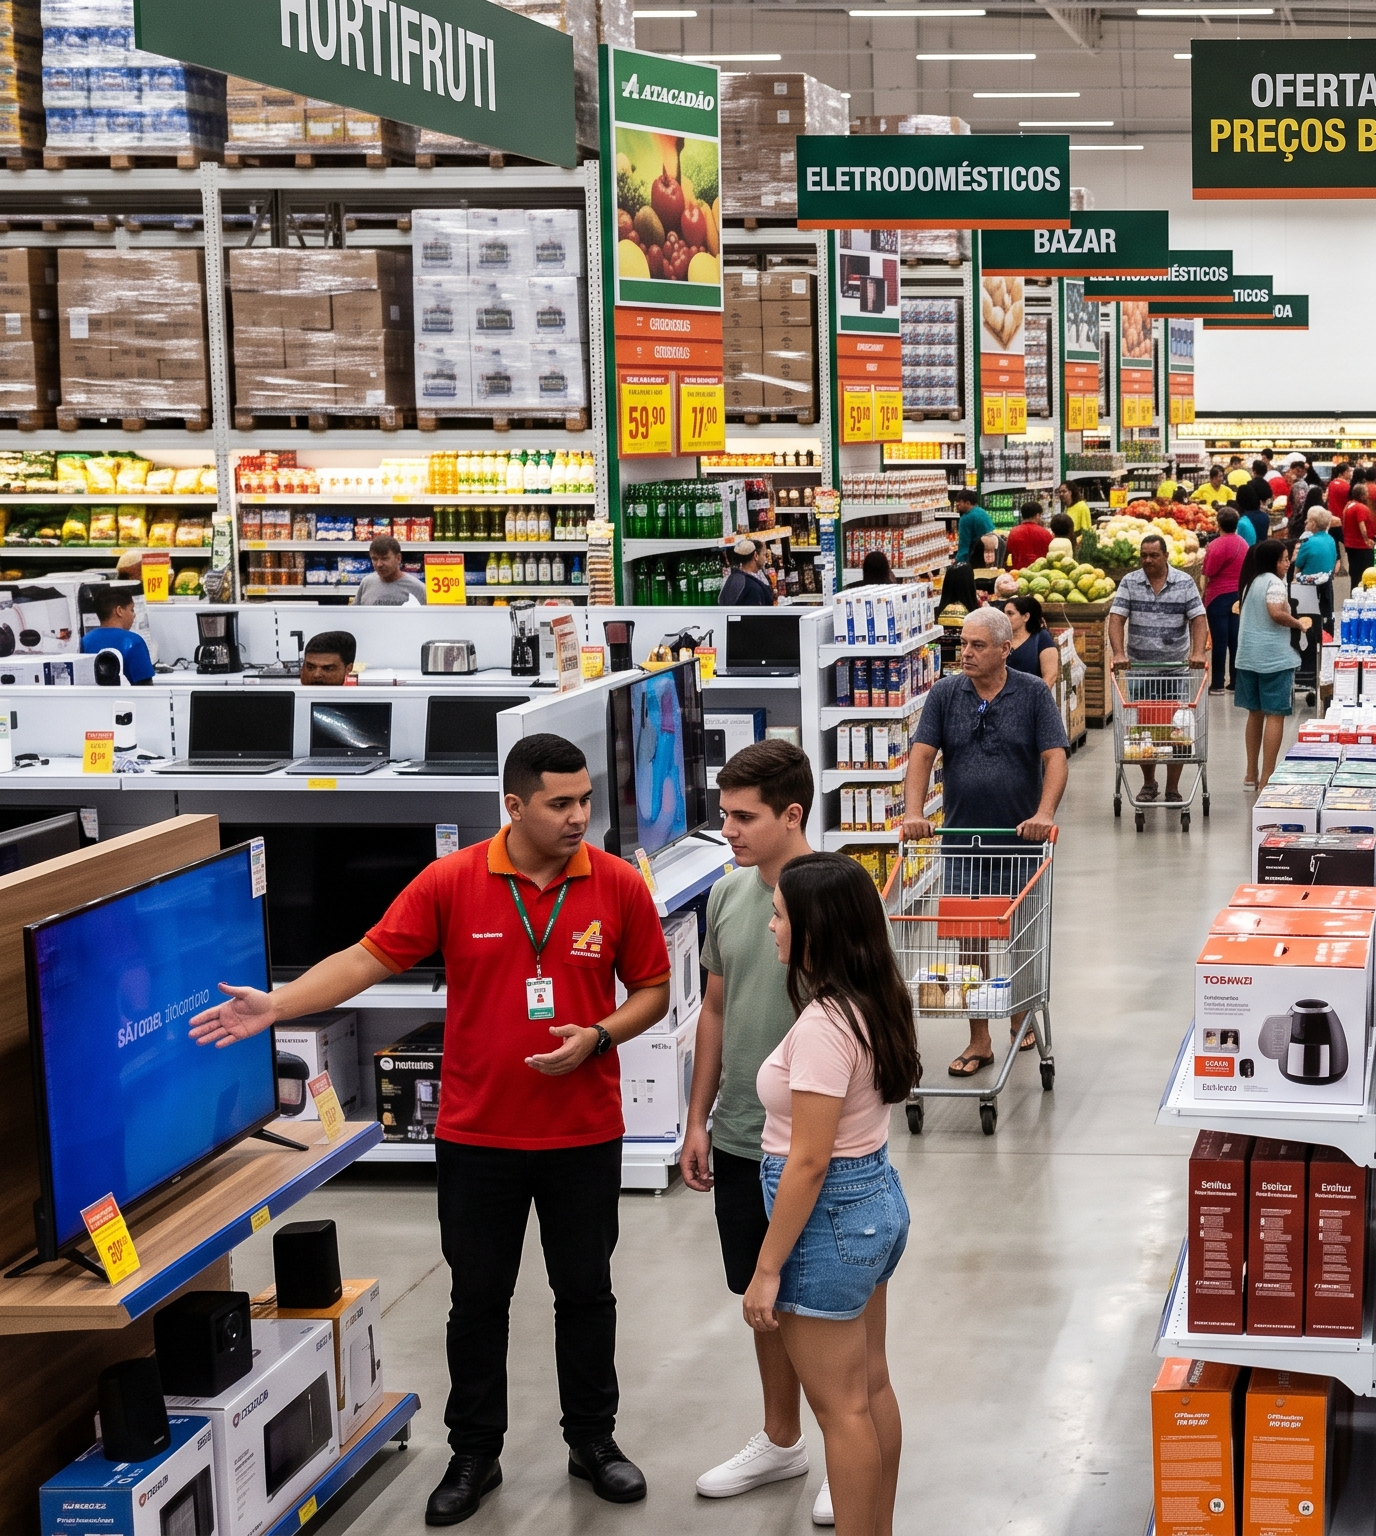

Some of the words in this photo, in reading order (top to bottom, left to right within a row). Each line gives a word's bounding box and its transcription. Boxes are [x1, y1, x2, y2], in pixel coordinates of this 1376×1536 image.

[280, 0, 496, 112] HORTIFRUTI
[640, 84, 715, 111] ATACADÃO
[1210, 118, 1346, 162] PREÇOS
[806, 161, 1061, 192] ELETRODOMÉSTICOS
[1034, 228, 1117, 254] BAZAR
